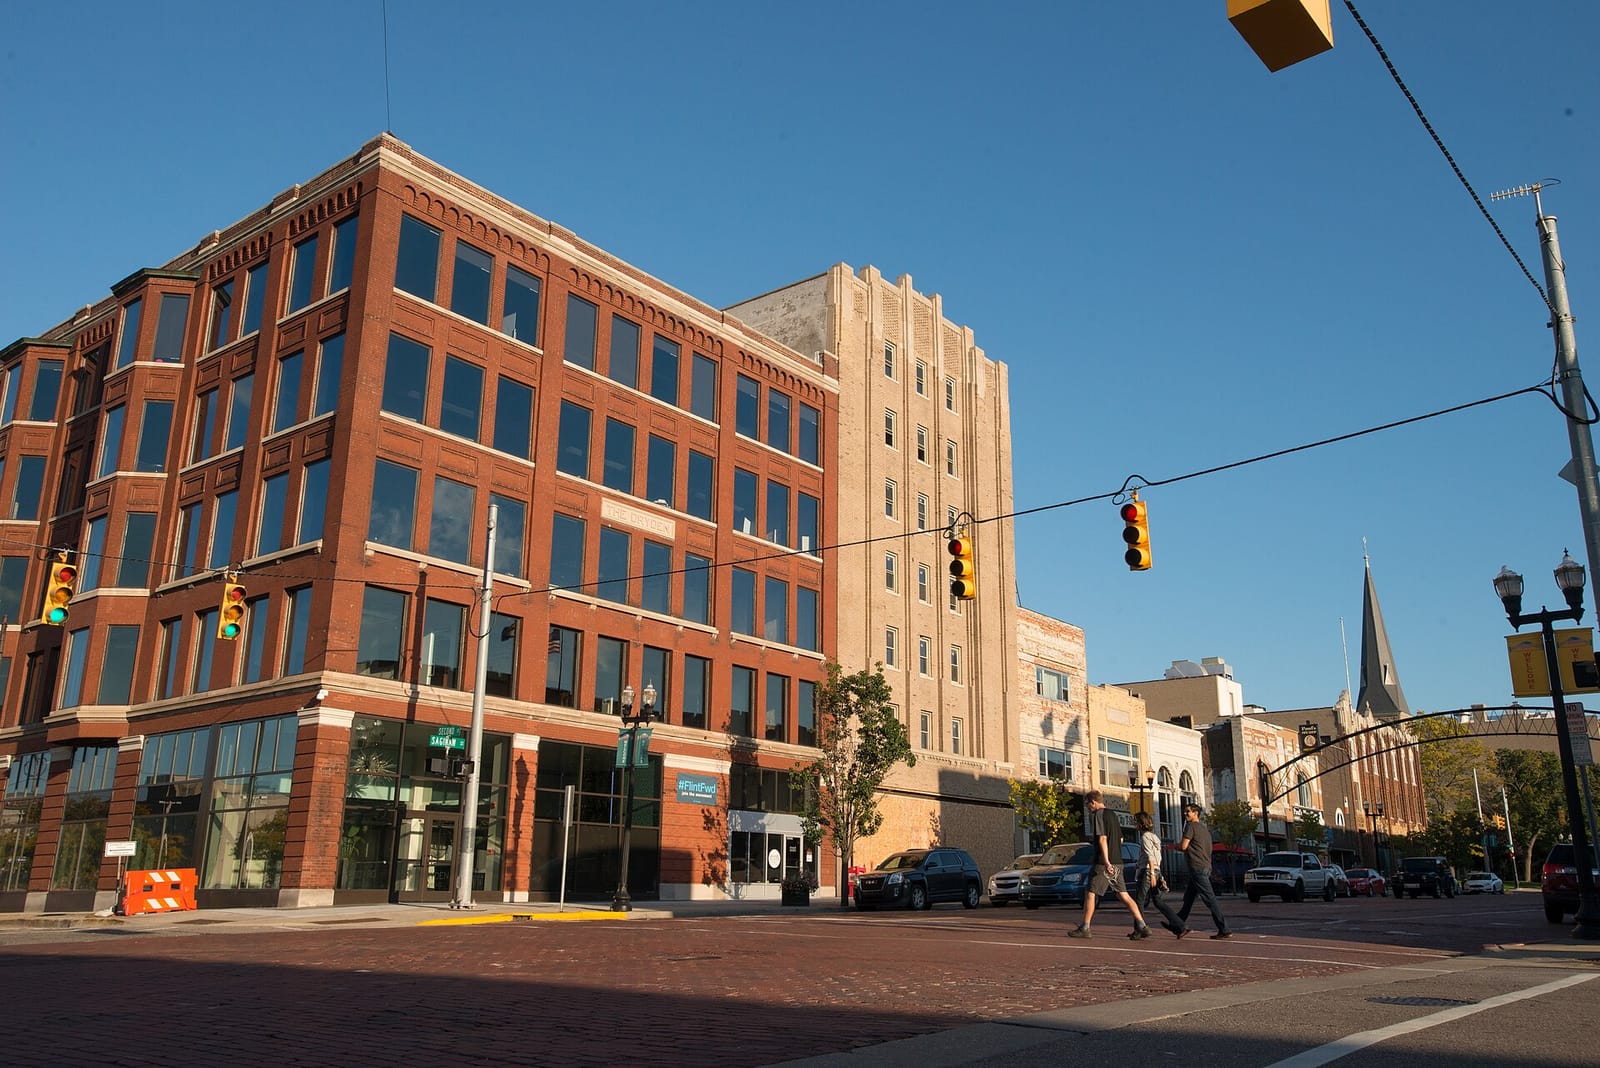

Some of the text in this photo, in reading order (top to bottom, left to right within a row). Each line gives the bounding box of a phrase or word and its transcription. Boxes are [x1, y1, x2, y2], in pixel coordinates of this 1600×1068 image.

[607, 503, 672, 537] THE DRYDEN
[1523, 651, 1535, 690] WELCOME
[1566, 704, 1577, 712] NO
[678, 779, 716, 794] #FlintFwd
